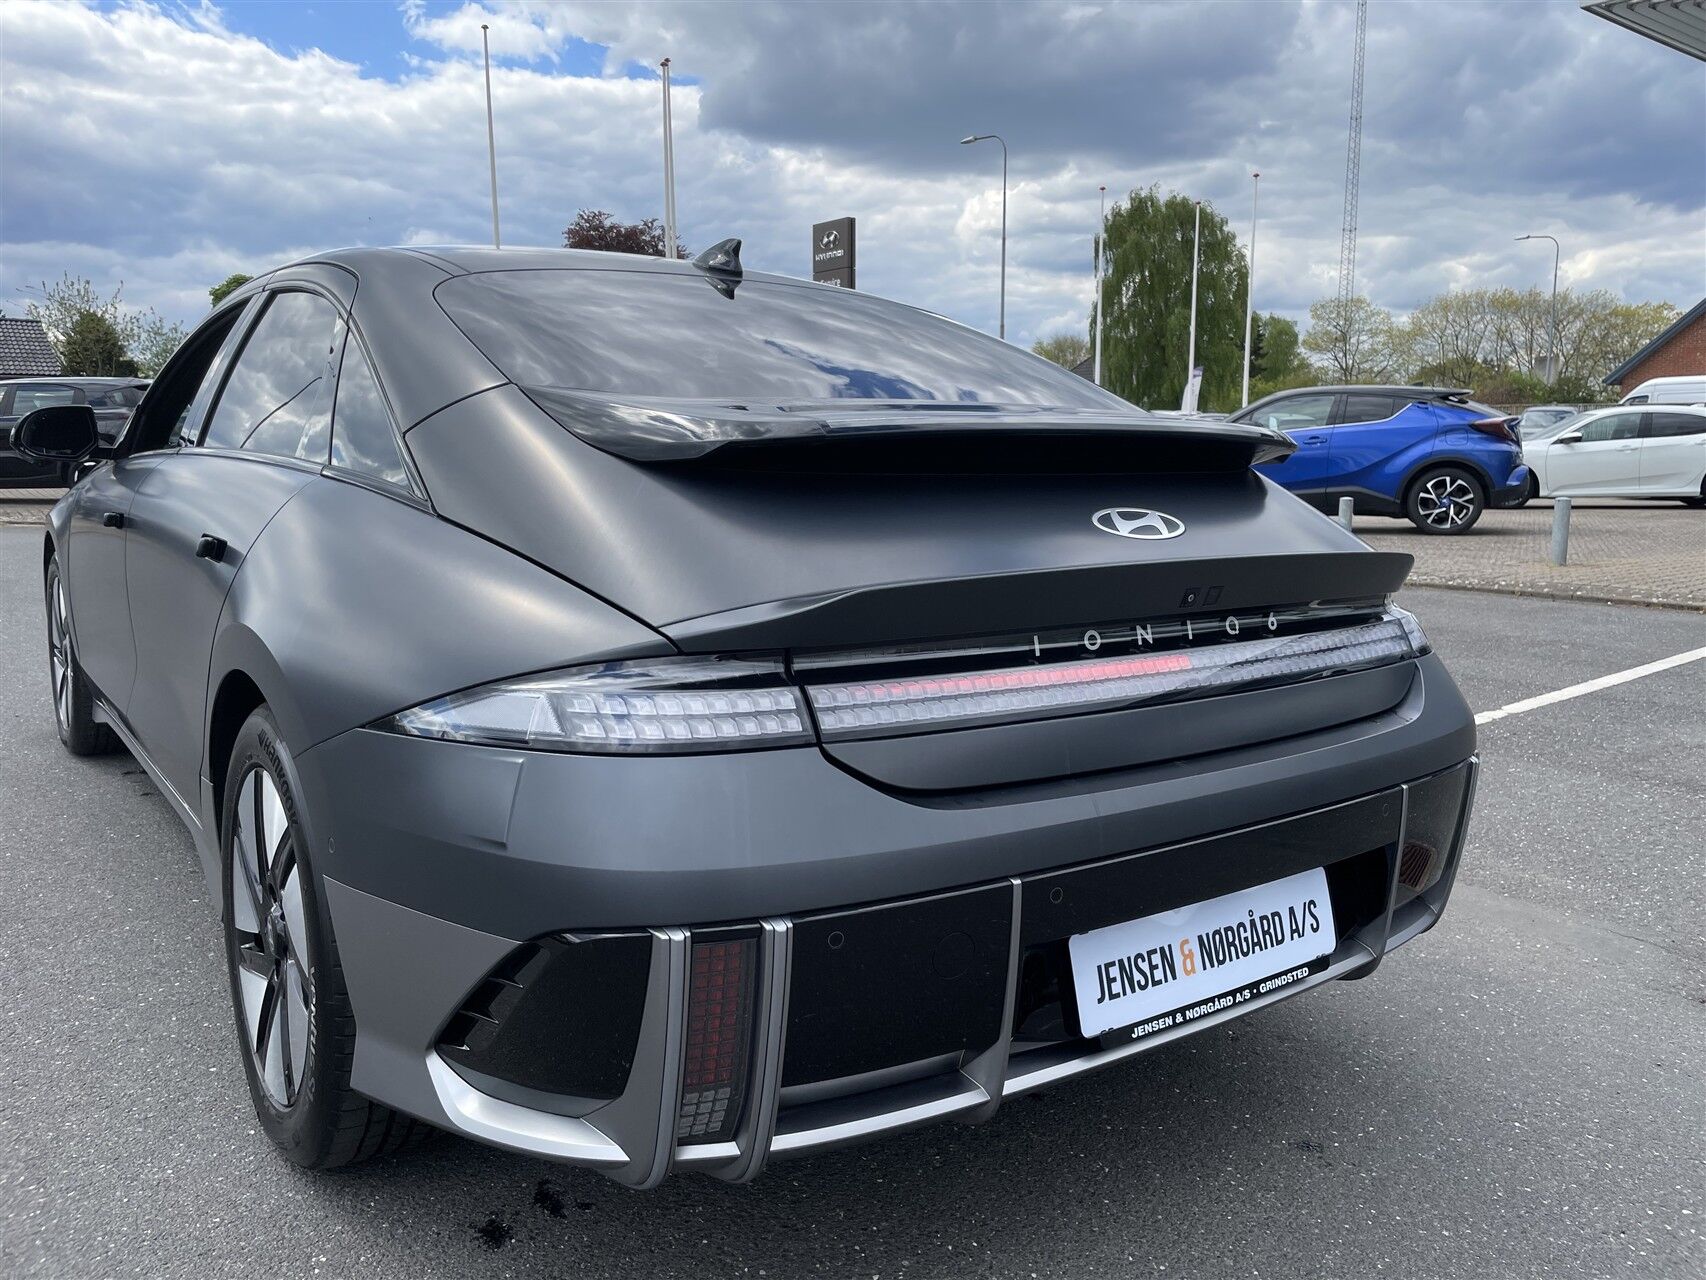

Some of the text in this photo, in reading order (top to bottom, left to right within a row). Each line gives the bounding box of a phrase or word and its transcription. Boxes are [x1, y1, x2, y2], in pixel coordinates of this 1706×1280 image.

[1096, 899, 1320, 1004] JENSEN & NØRGÅRD A/S
[1131, 966, 1310, 1039] JENSEN & NØRGÅRD A/S GRINDSTED
